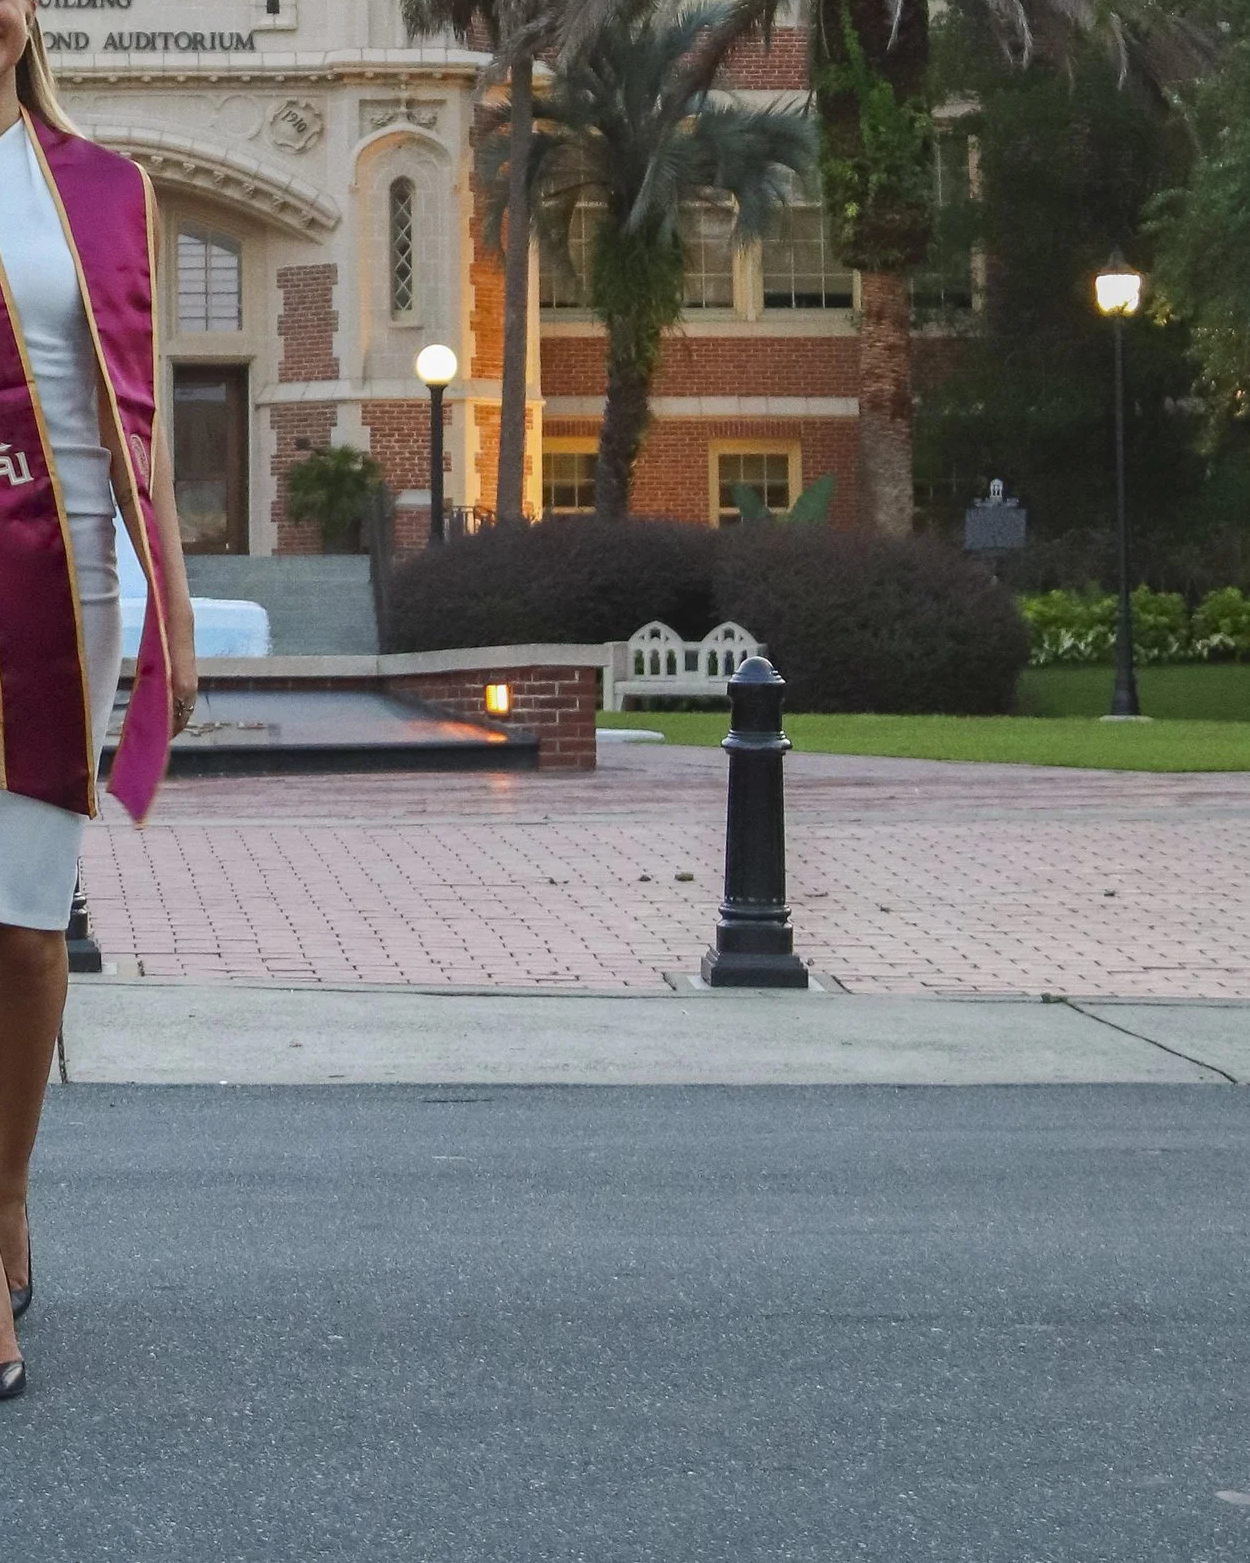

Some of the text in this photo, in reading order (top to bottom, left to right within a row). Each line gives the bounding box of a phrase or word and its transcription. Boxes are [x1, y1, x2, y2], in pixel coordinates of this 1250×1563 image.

[42, 31, 256, 51] OND AUDITORIUM
[281, 110, 307, 133] 1910
